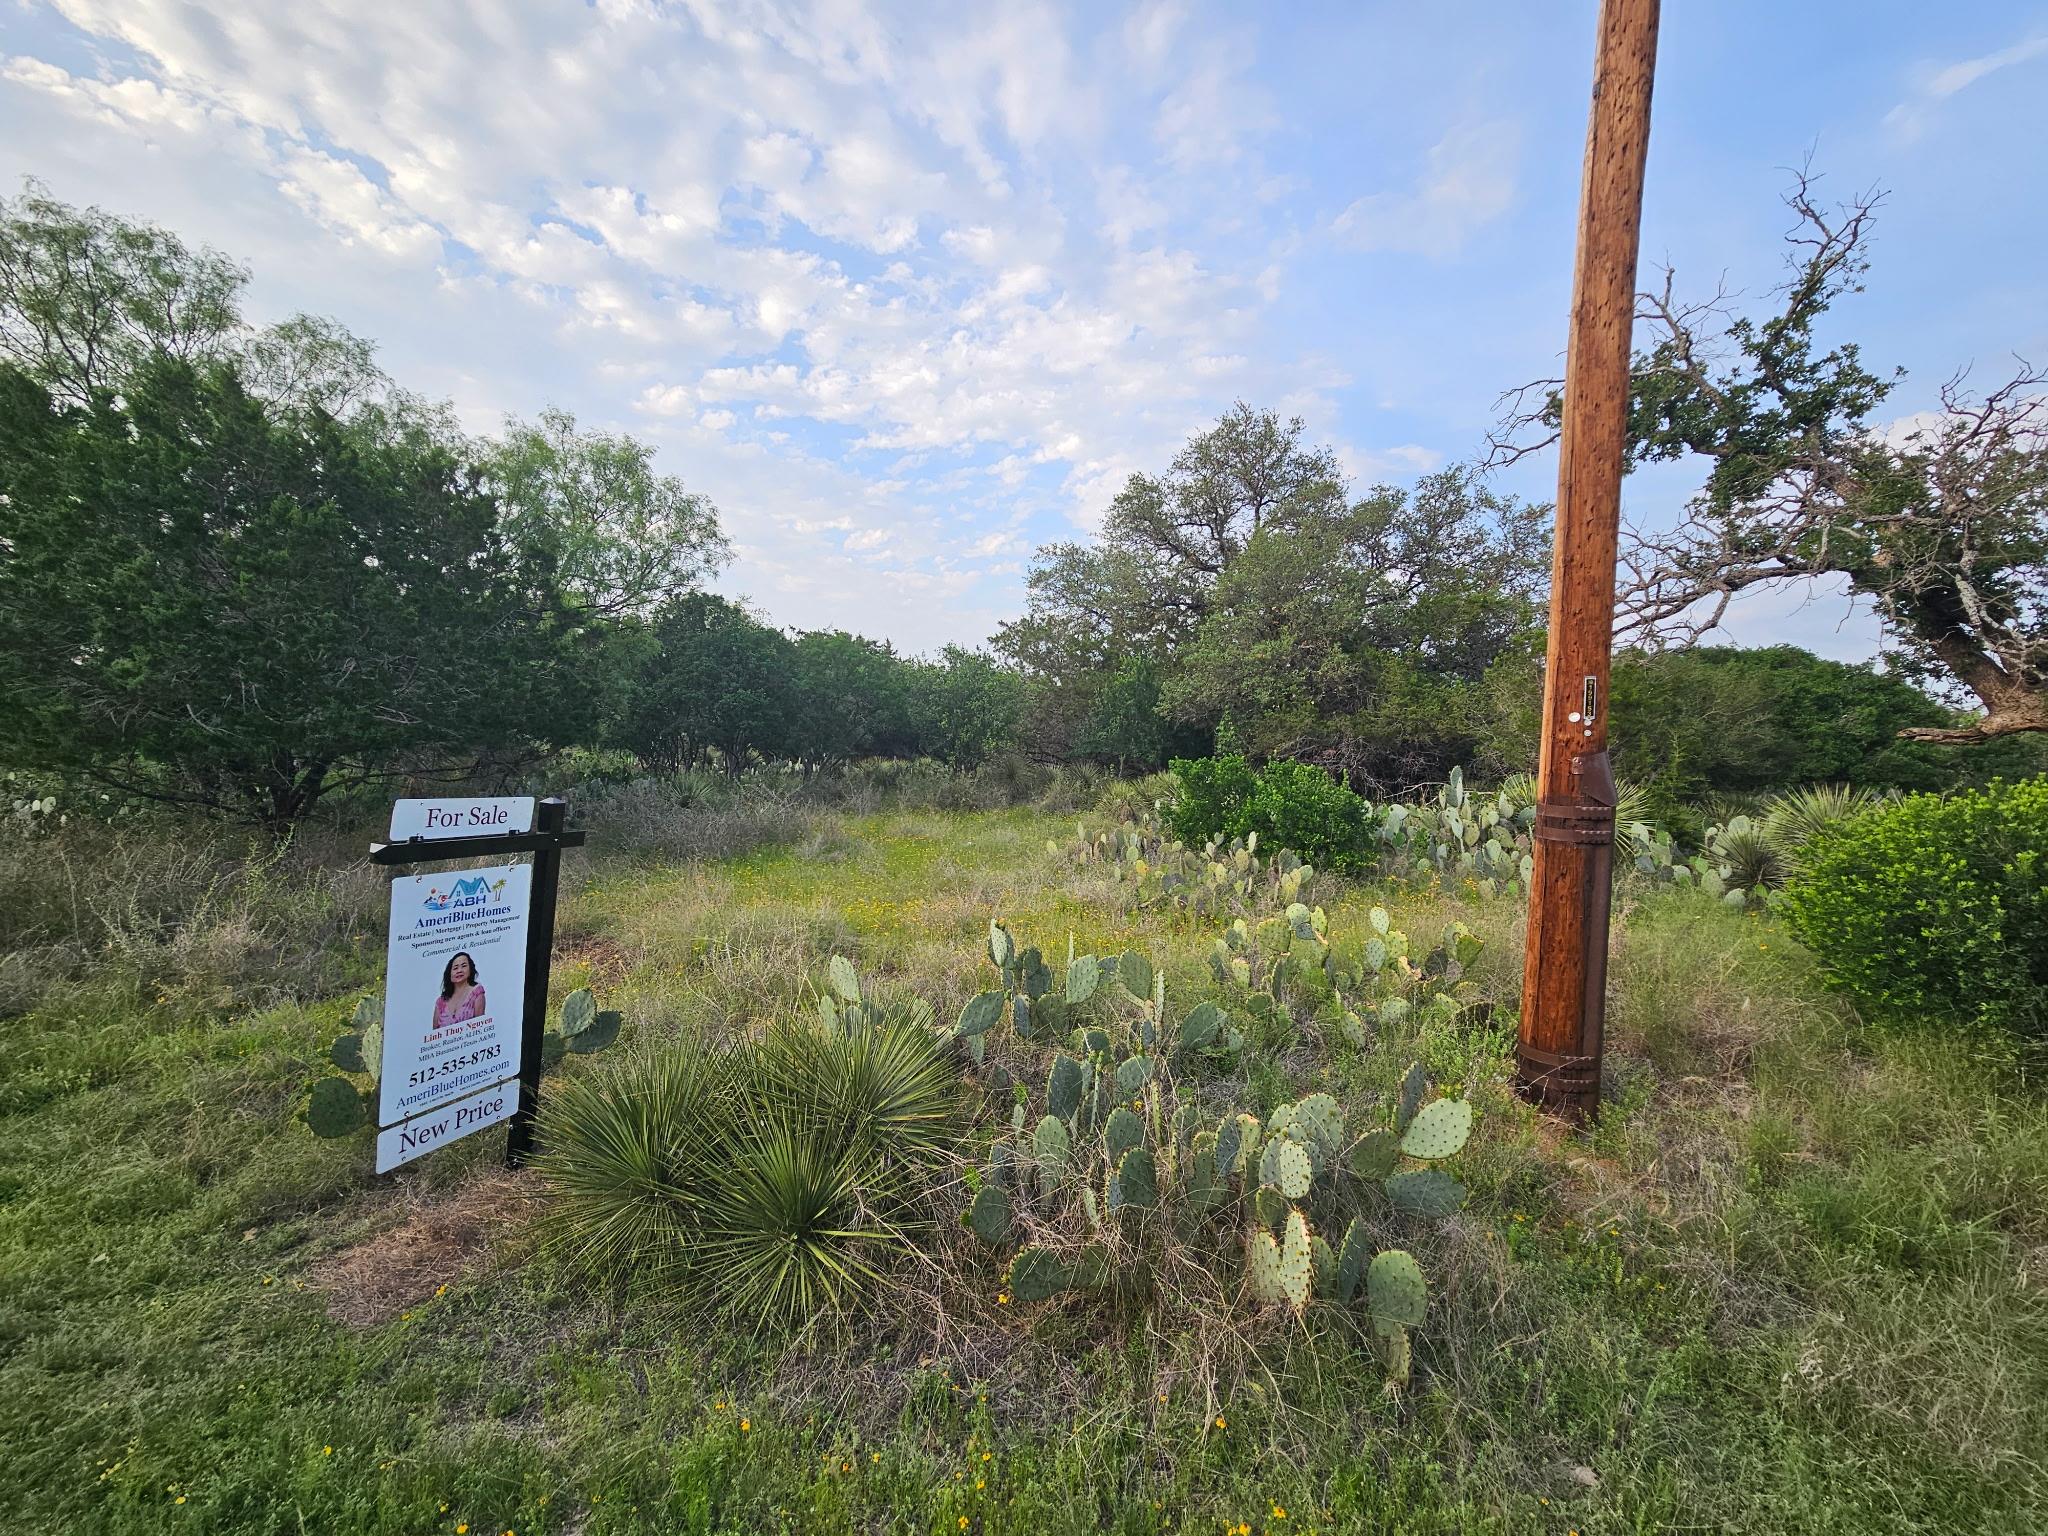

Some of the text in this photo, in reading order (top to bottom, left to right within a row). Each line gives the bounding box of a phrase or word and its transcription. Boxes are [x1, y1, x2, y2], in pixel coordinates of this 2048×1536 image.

[425, 805, 508, 827] For Sale
[453, 895, 487, 908] ABH
[398, 934, 412, 942] Real
[413, 931, 431, 940] Estate
[435, 925, 461, 935] Mortgage
[466, 921, 488, 931] Property
[489, 915, 520, 925] Management
[415, 906, 511, 929] AmeriBlueHomes
[412, 938, 444, 950] Sponsoring
[457, 932, 475, 941] agents
[493, 925, 511, 933] officers
[423, 935, 502, 958] Commercial & Residential
[424, 1017, 493, 1043] Linh Thuy Nguyen
[409, 1044, 501, 1088] 512-535-8783
[396, 1060, 510, 1110] AmeriBlueHomes.com
[398, 1119, 450, 1154] New
[454, 1097, 503, 1130] Price
